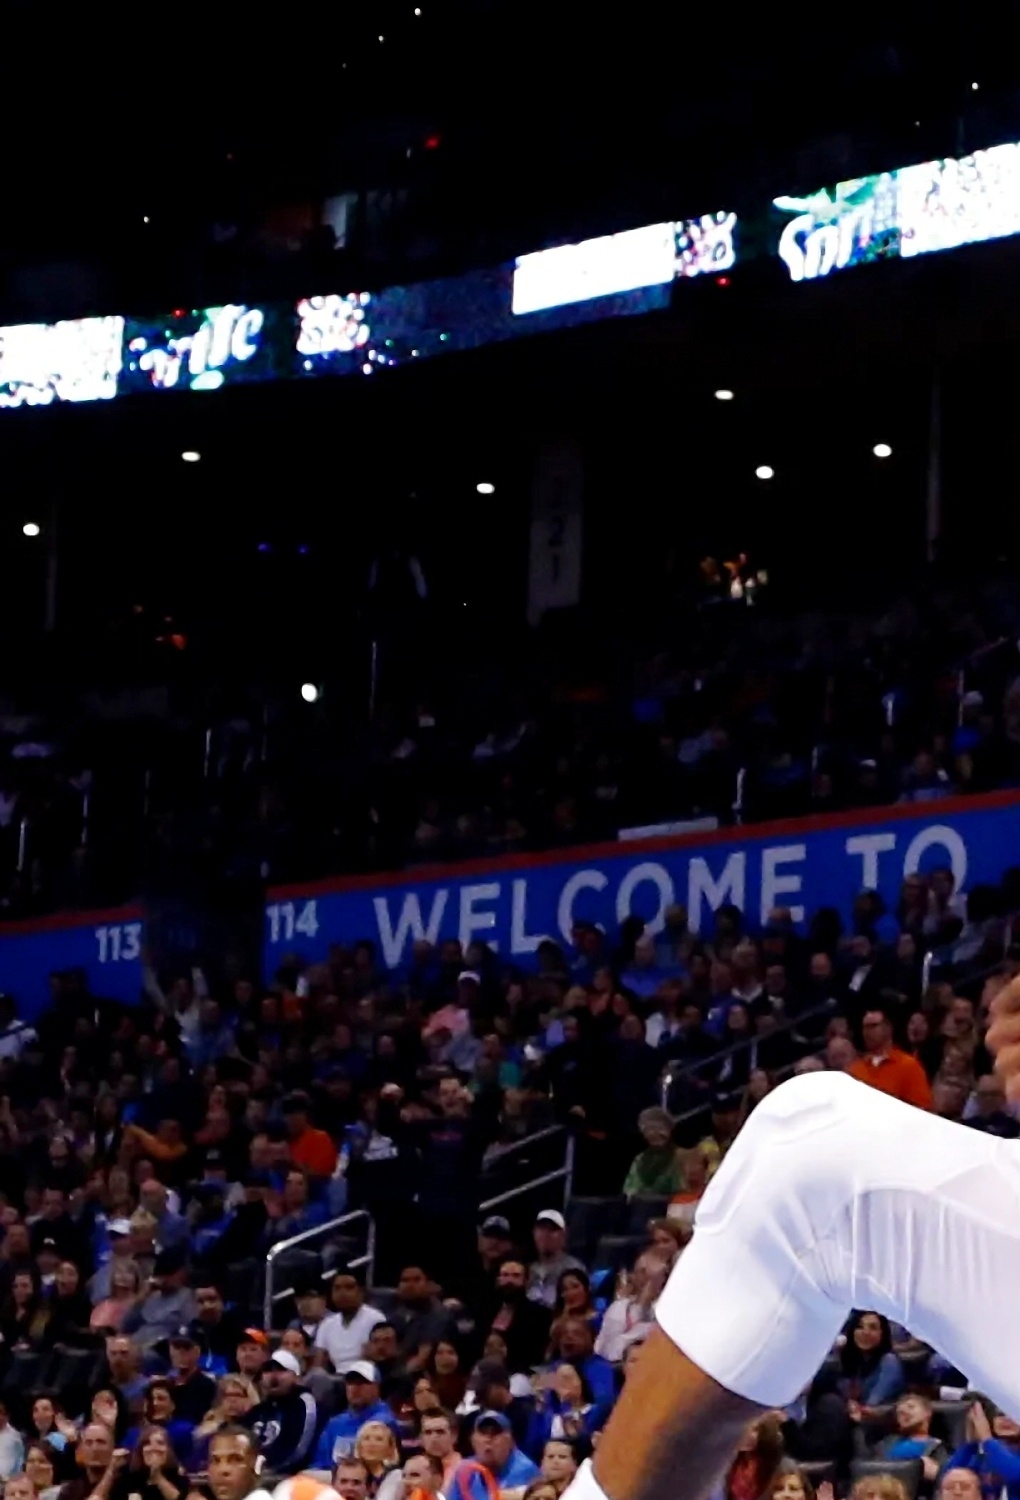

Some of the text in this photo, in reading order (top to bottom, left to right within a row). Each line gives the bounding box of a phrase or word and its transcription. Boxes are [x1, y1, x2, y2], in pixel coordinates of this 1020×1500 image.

[373, 824, 967, 970] WELCOME TO
[95, 921, 142, 964] 113
[265, 899, 320, 944] 114
